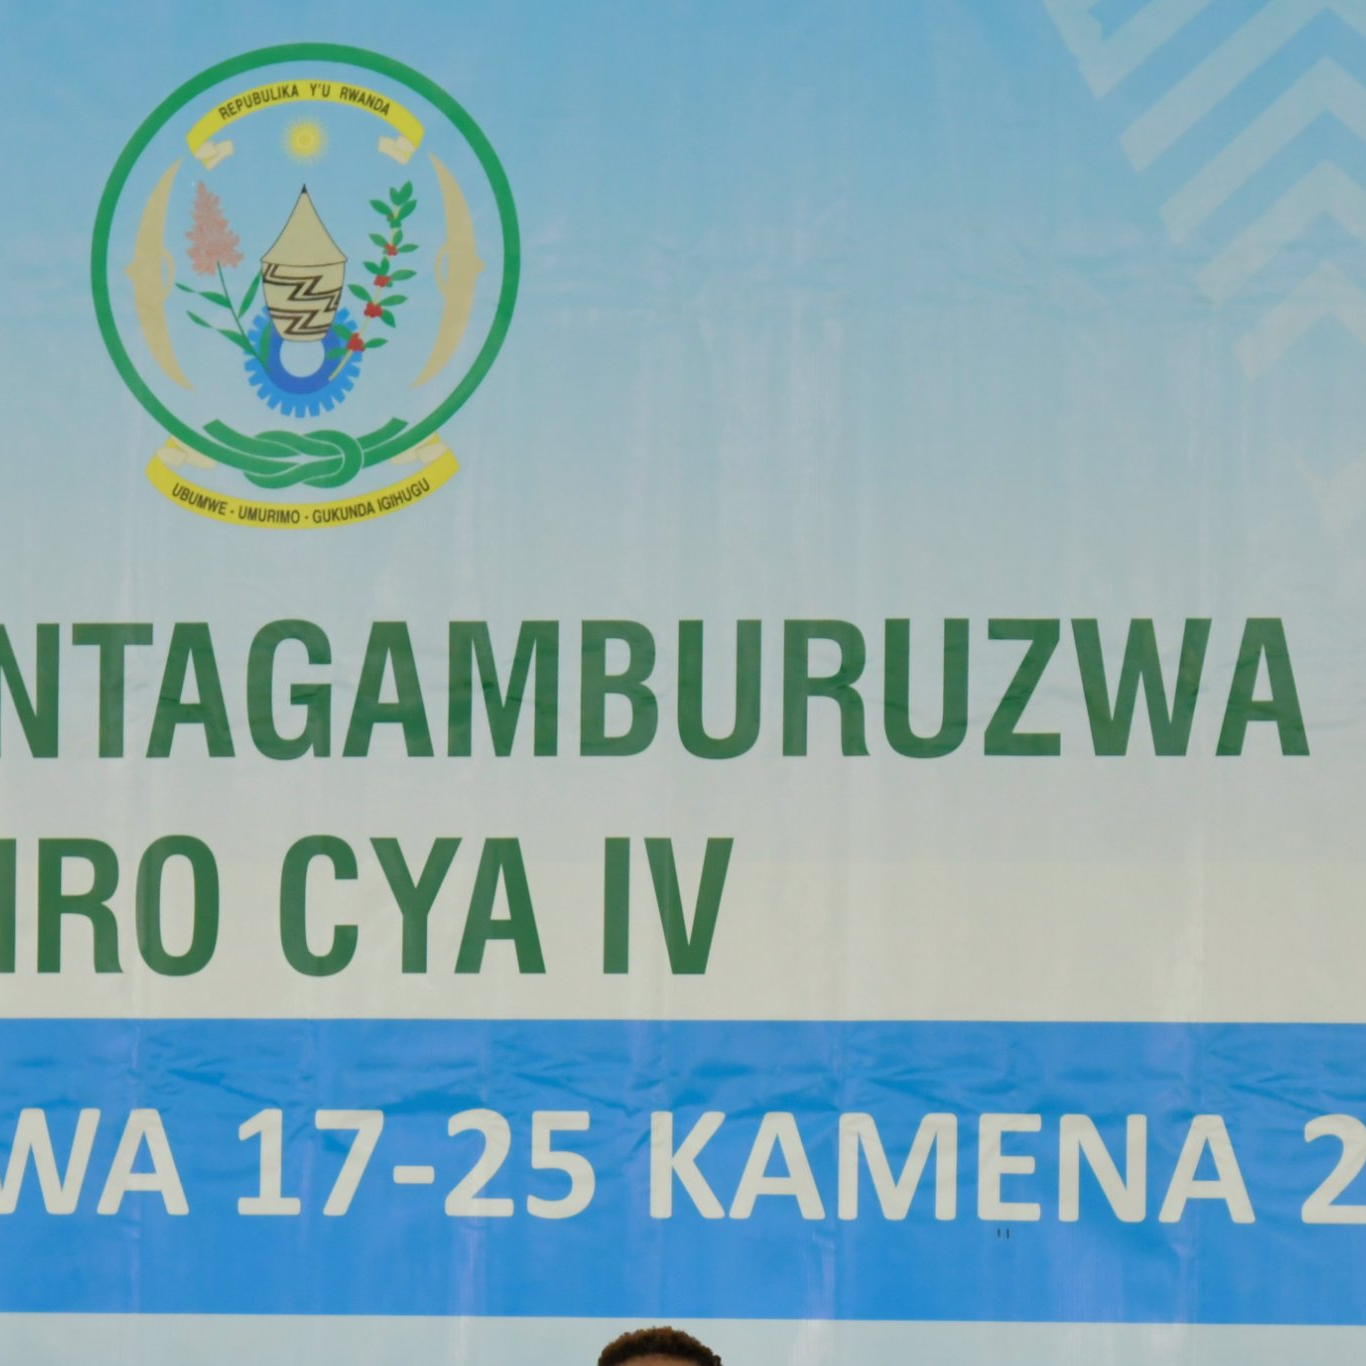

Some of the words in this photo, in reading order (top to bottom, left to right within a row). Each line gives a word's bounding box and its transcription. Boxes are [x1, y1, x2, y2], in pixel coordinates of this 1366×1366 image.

[218, 83, 299, 120] REPUBULIKA
[309, 83, 331, 98] Y'U
[339, 86, 391, 116] RWANDA
[171, 483, 227, 516] UBUMWE
[238, 505, 300, 523] UMURIMO
[313, 502, 376, 524] GUKUNDA
[378, 477, 431, 511] IGIHUGU
[280, 835, 546, 977] CYA
[603, 837, 734, 975] IV
[237, 1108, 596, 1220] 17-25
[649, 1111, 1256, 1224] KAMENA
